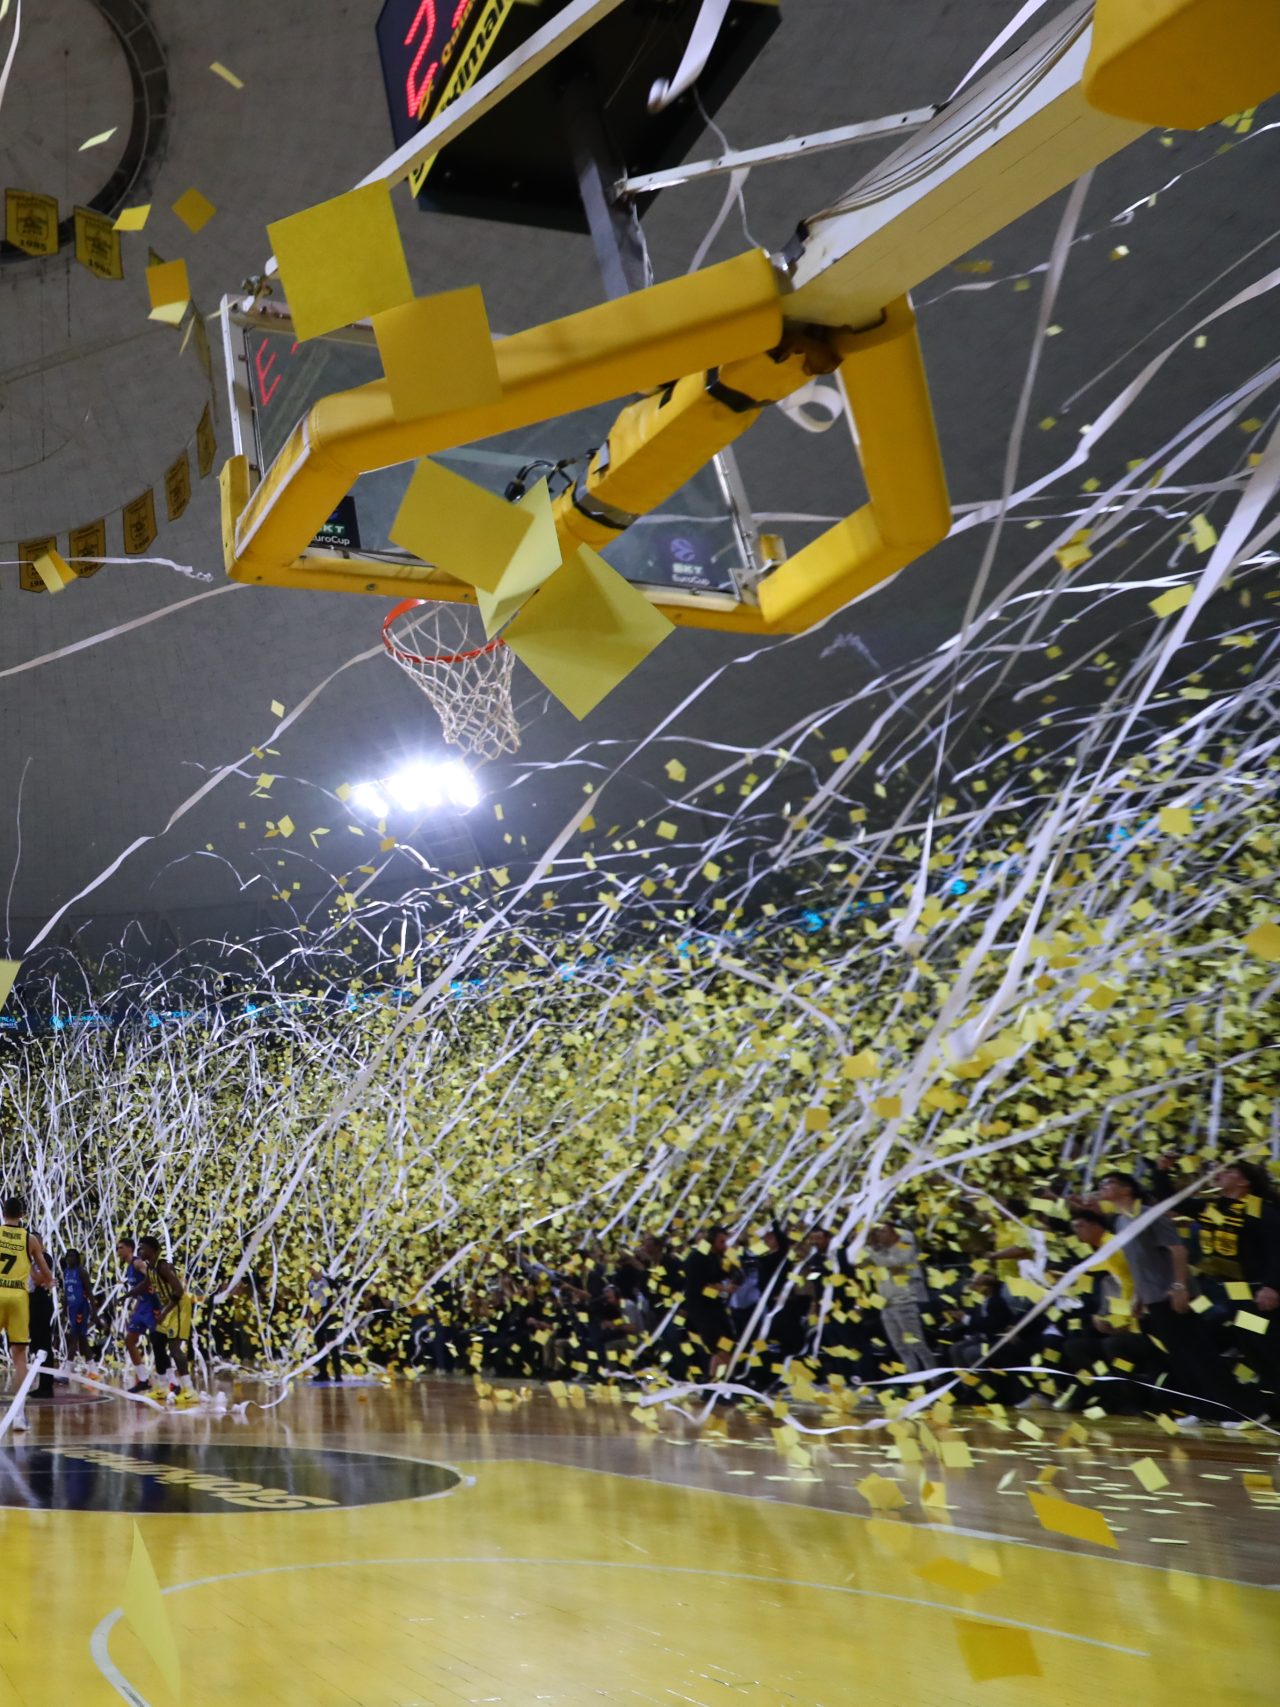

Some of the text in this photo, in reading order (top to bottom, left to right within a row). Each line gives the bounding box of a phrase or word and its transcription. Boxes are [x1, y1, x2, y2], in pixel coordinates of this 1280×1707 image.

[319, 525, 345, 534] KT
[314, 535, 351, 546] uroCup
[0, 1252, 18, 1275] 7
